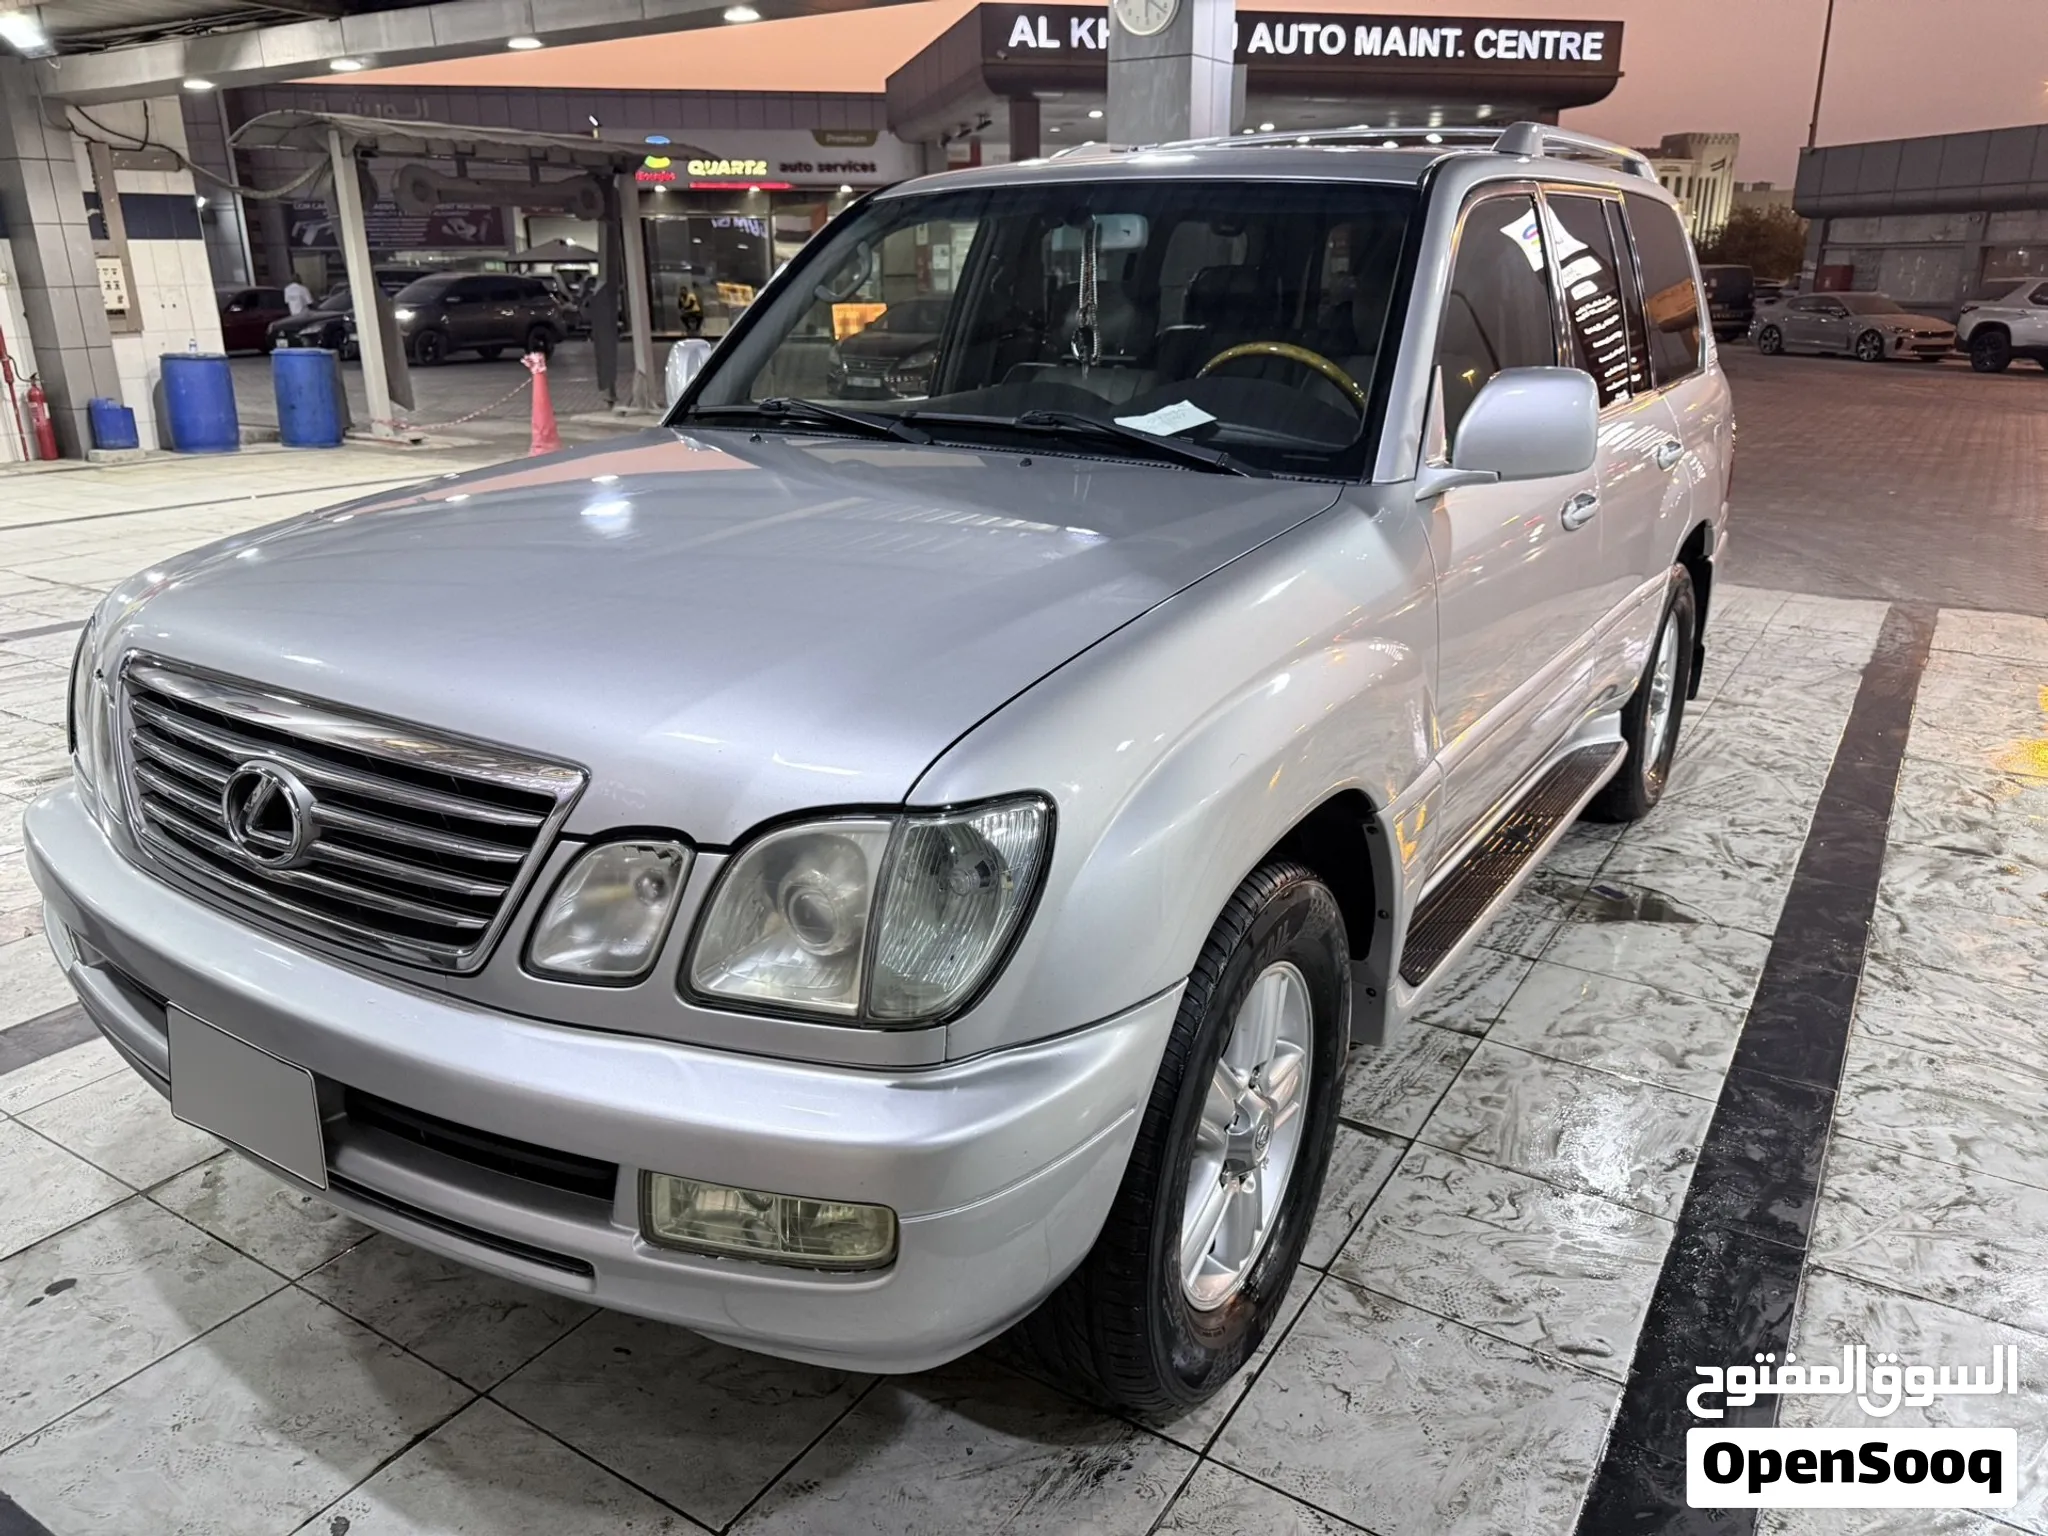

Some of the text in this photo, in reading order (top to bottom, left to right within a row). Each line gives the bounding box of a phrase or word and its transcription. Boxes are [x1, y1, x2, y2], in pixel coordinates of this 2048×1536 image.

[1008, 15, 1061, 49] AL
[1247, 22, 1347, 56] AUTO
[1354, 26, 1466, 58] MAINT.
[1474, 29, 1605, 62] CENTRE
[687, 160, 767, 176] QUARTZ
[779, 161, 877, 174] auto services
